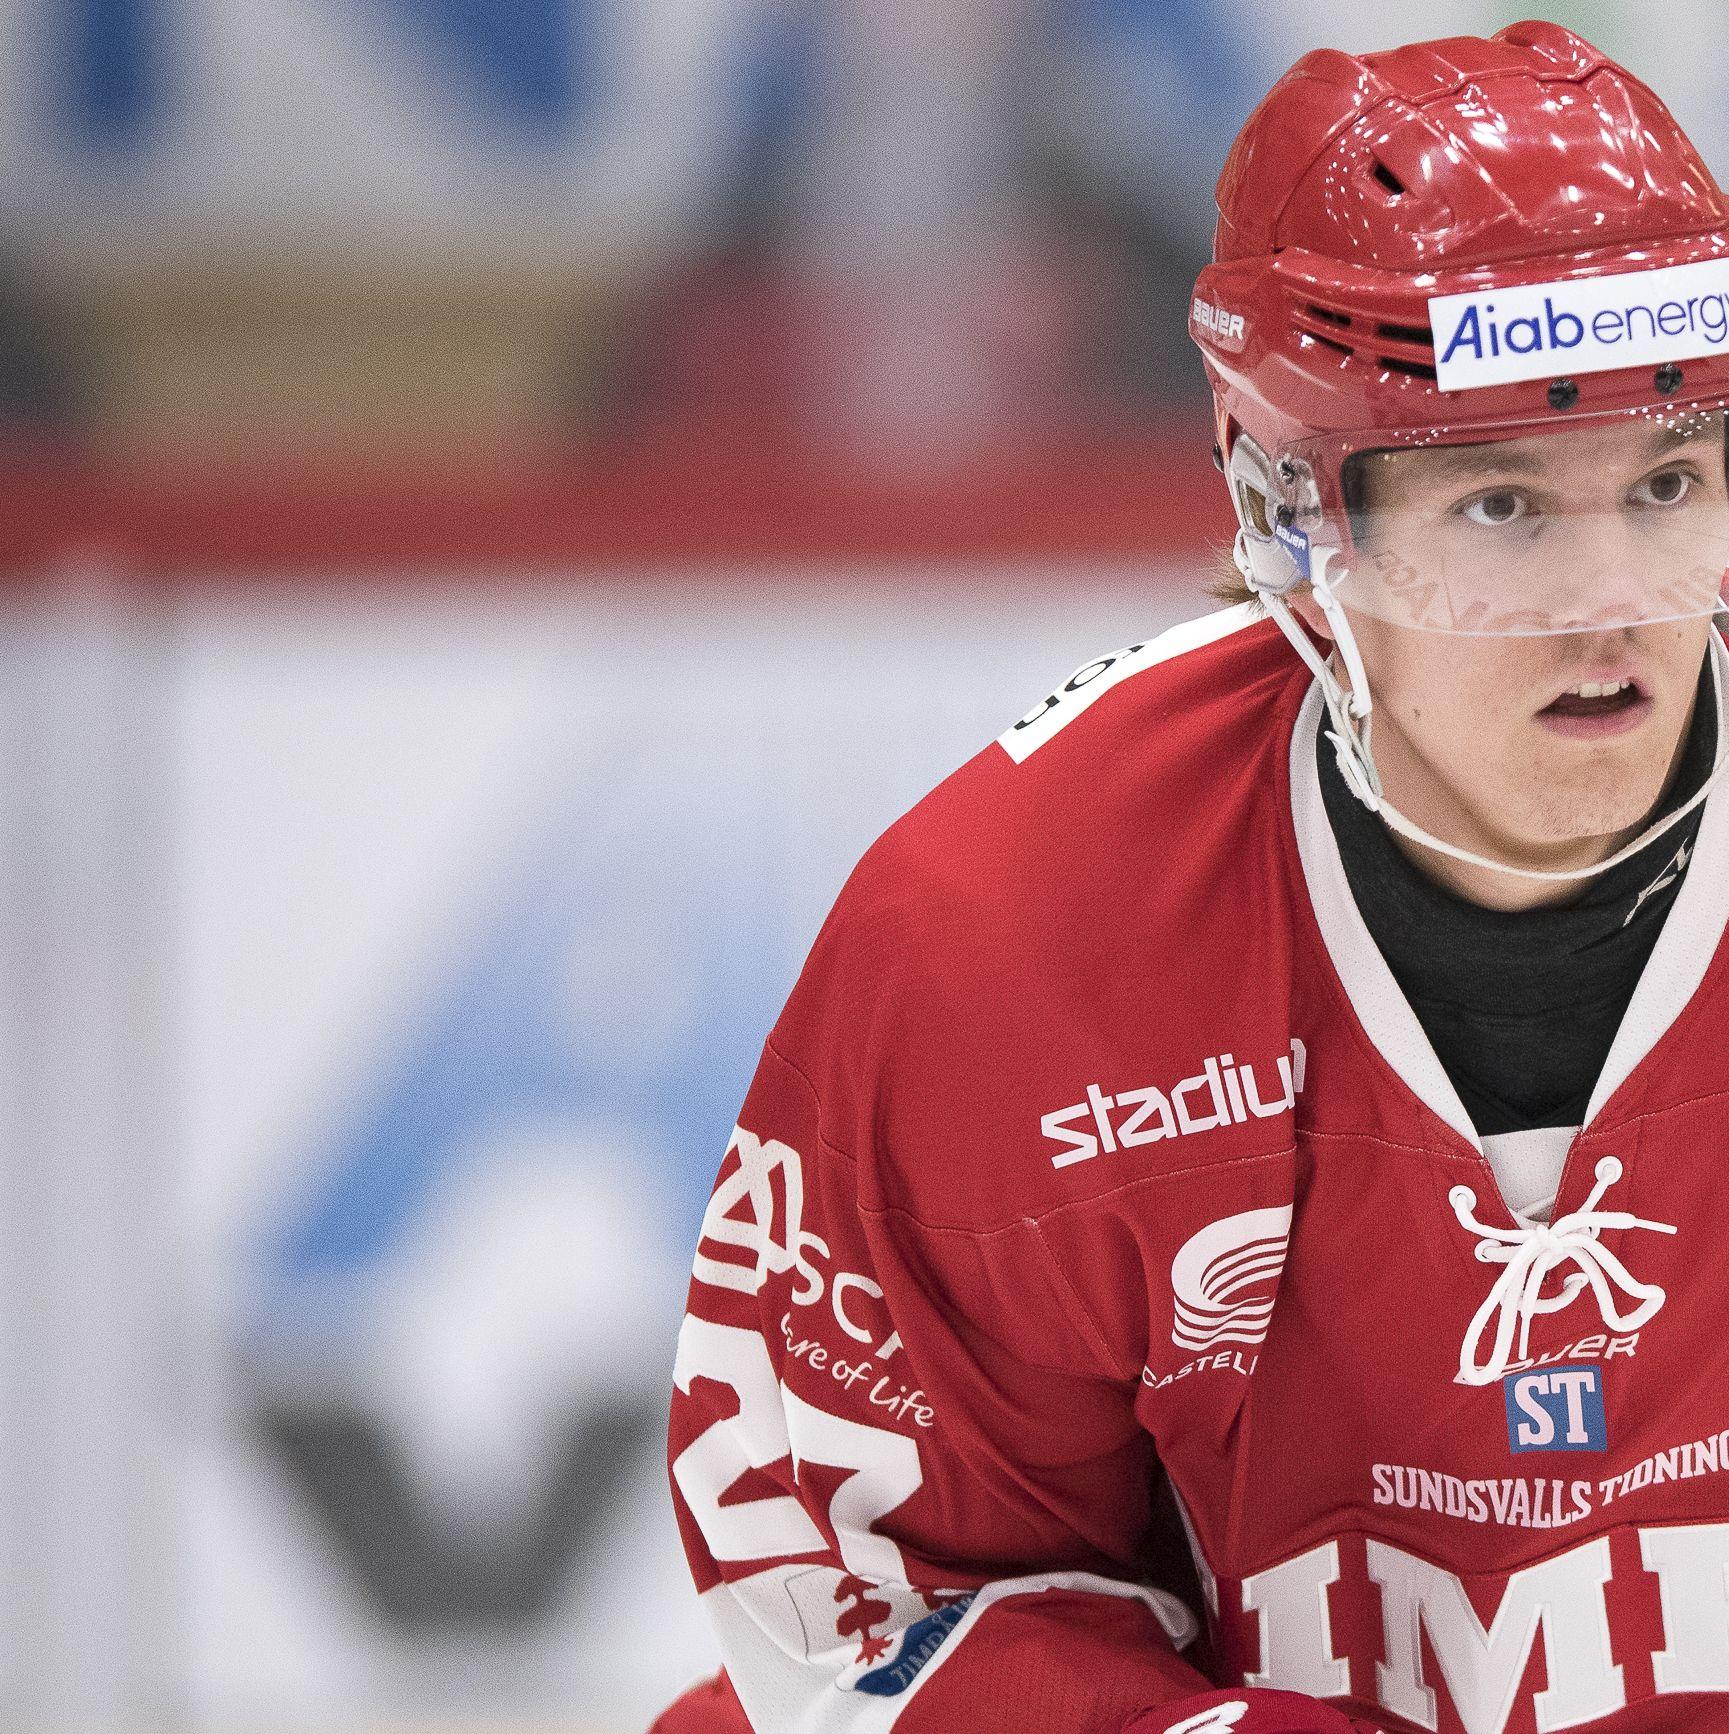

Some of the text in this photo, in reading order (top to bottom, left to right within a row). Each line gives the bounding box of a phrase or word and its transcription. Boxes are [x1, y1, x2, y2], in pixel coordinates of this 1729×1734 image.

[1193, 298, 1245, 341] BAUER
[831, 1359, 873, 1391] of
[1514, 1371, 1596, 1446] ST
[1372, 1463, 1592, 1529] SUNDSVALLS
